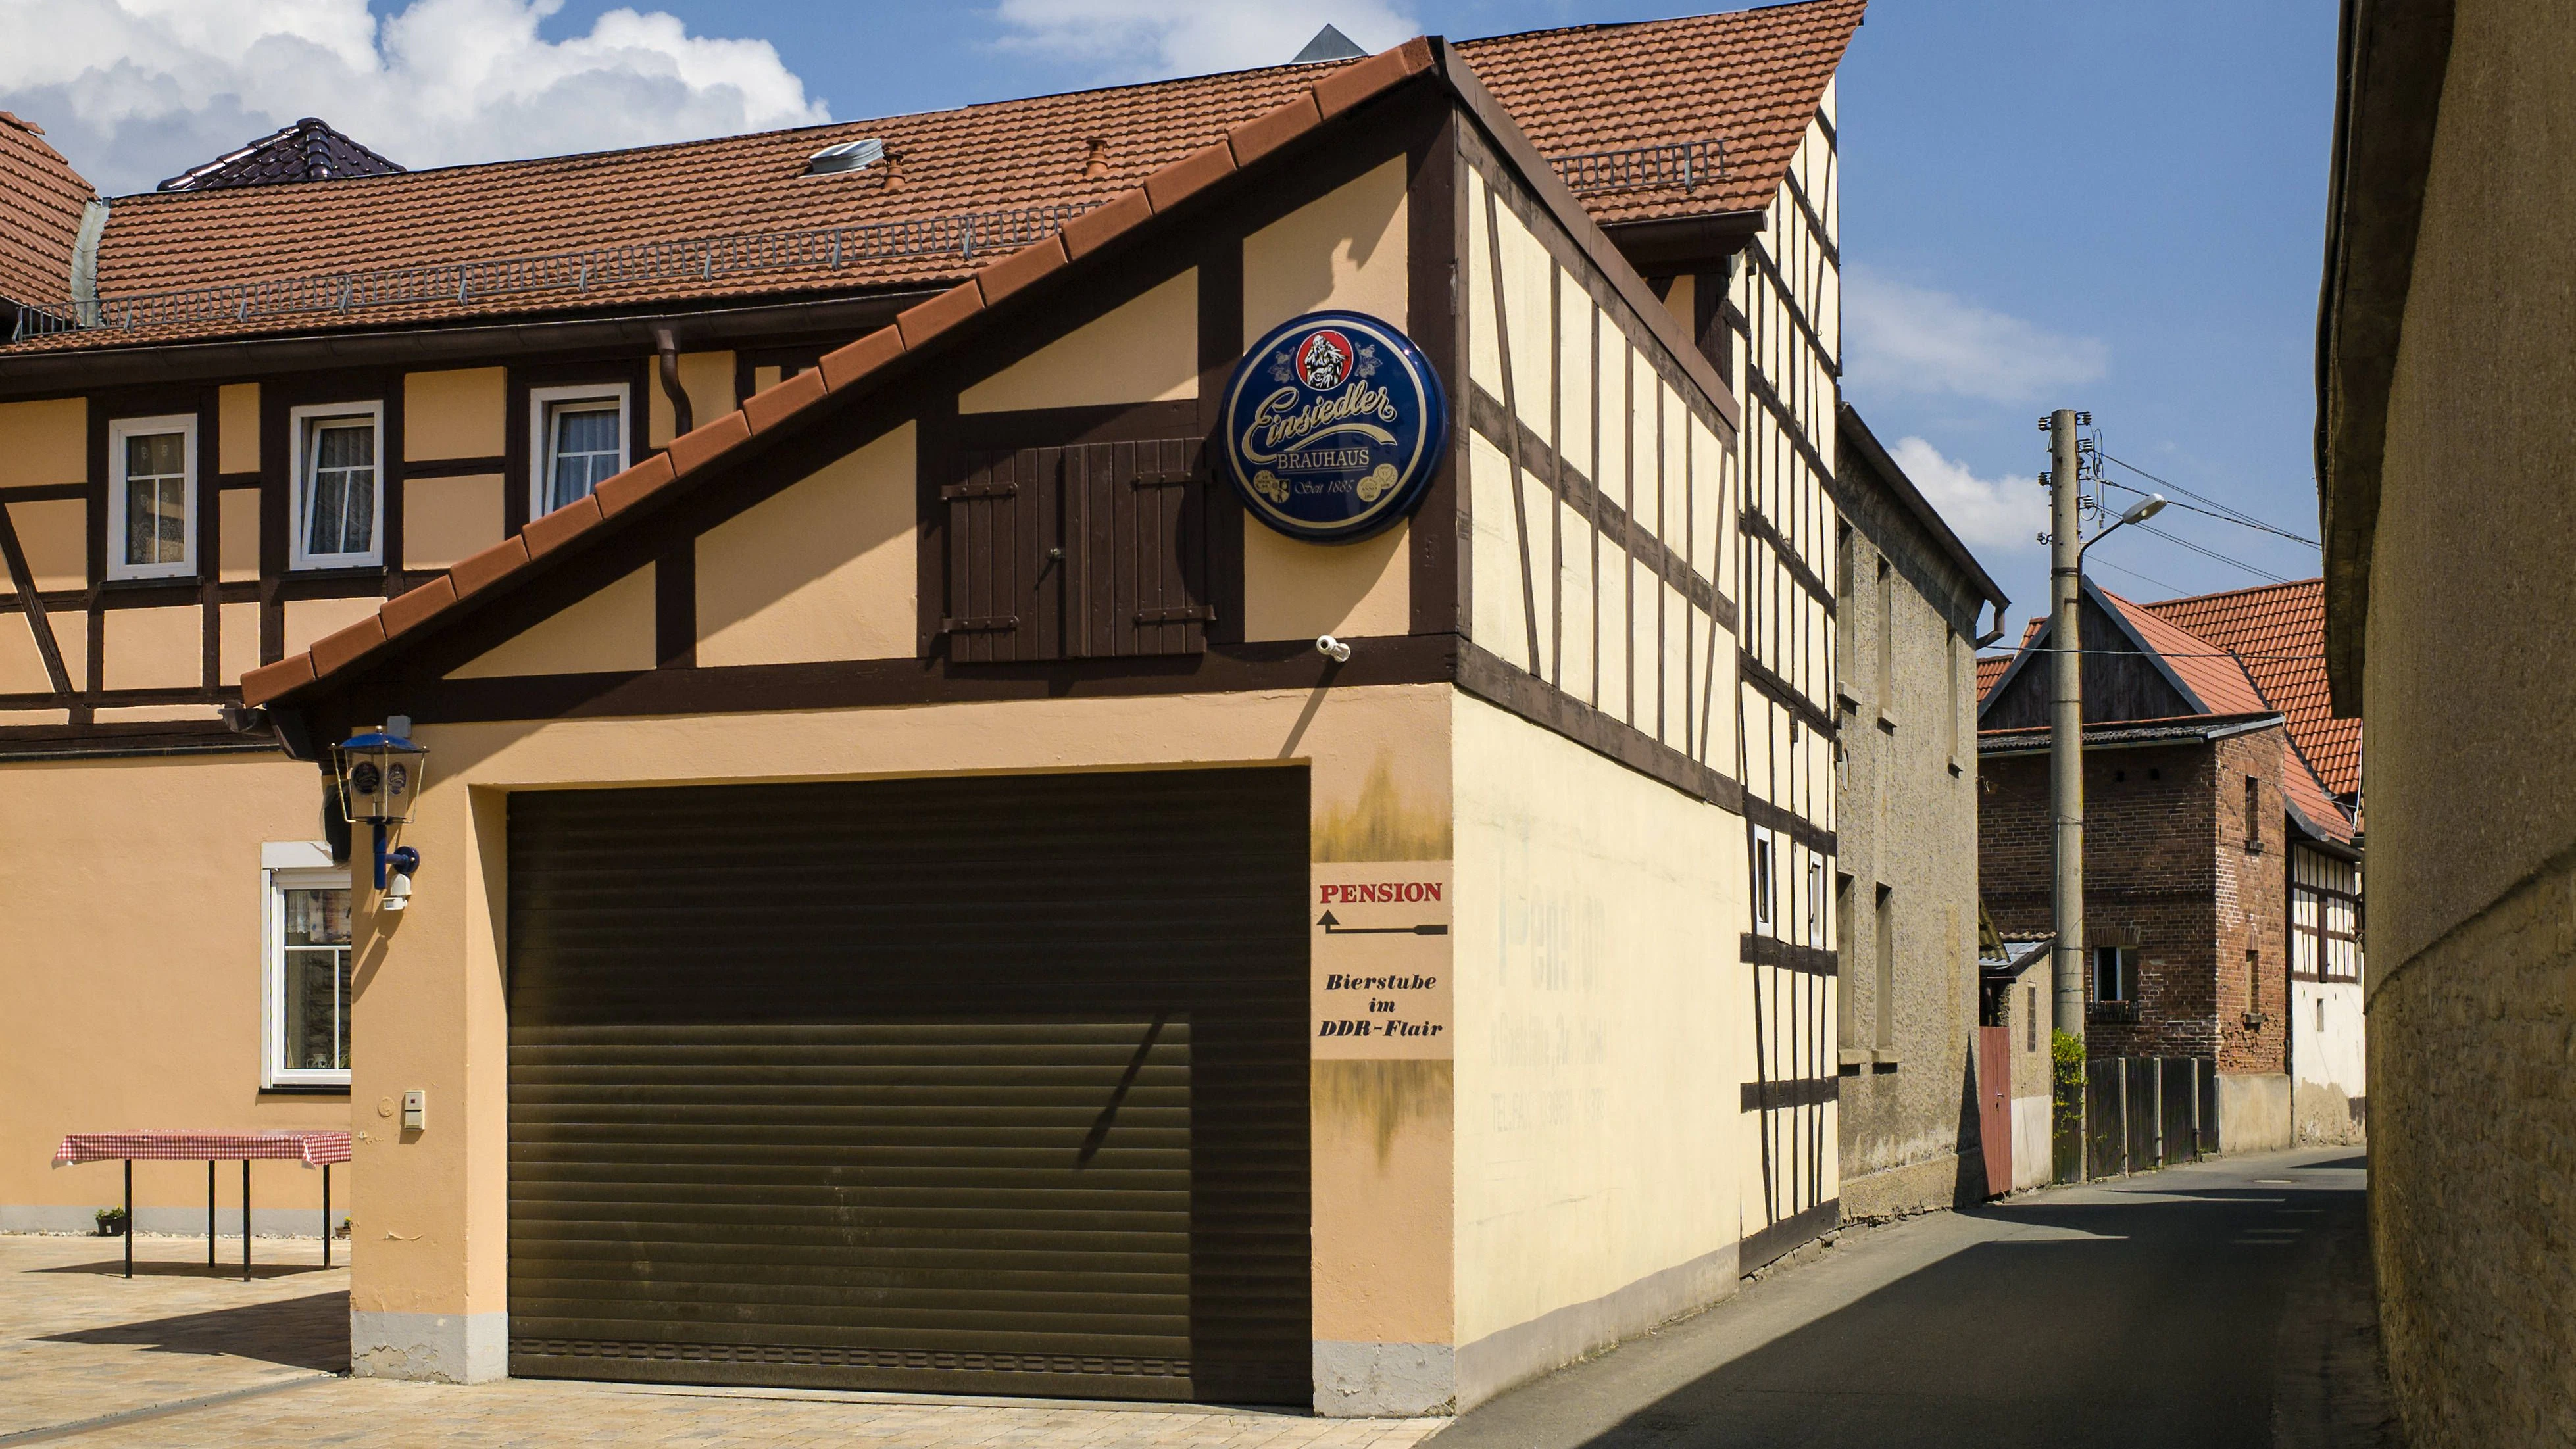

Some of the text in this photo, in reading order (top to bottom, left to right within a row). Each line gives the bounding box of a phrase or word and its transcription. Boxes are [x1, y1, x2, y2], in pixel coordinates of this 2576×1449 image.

[1242, 380, 1397, 464] Einsiedler
[1277, 449, 1370, 470] BRAUHAUS
[1294, 479, 1355, 495] Seit 1885
[1320, 882, 1443, 904] PENSION
[1324, 974, 1437, 991] Bierstube
[1368, 997, 1395, 1012] im
[1318, 1019, 1443, 1037] DDR-Flair
